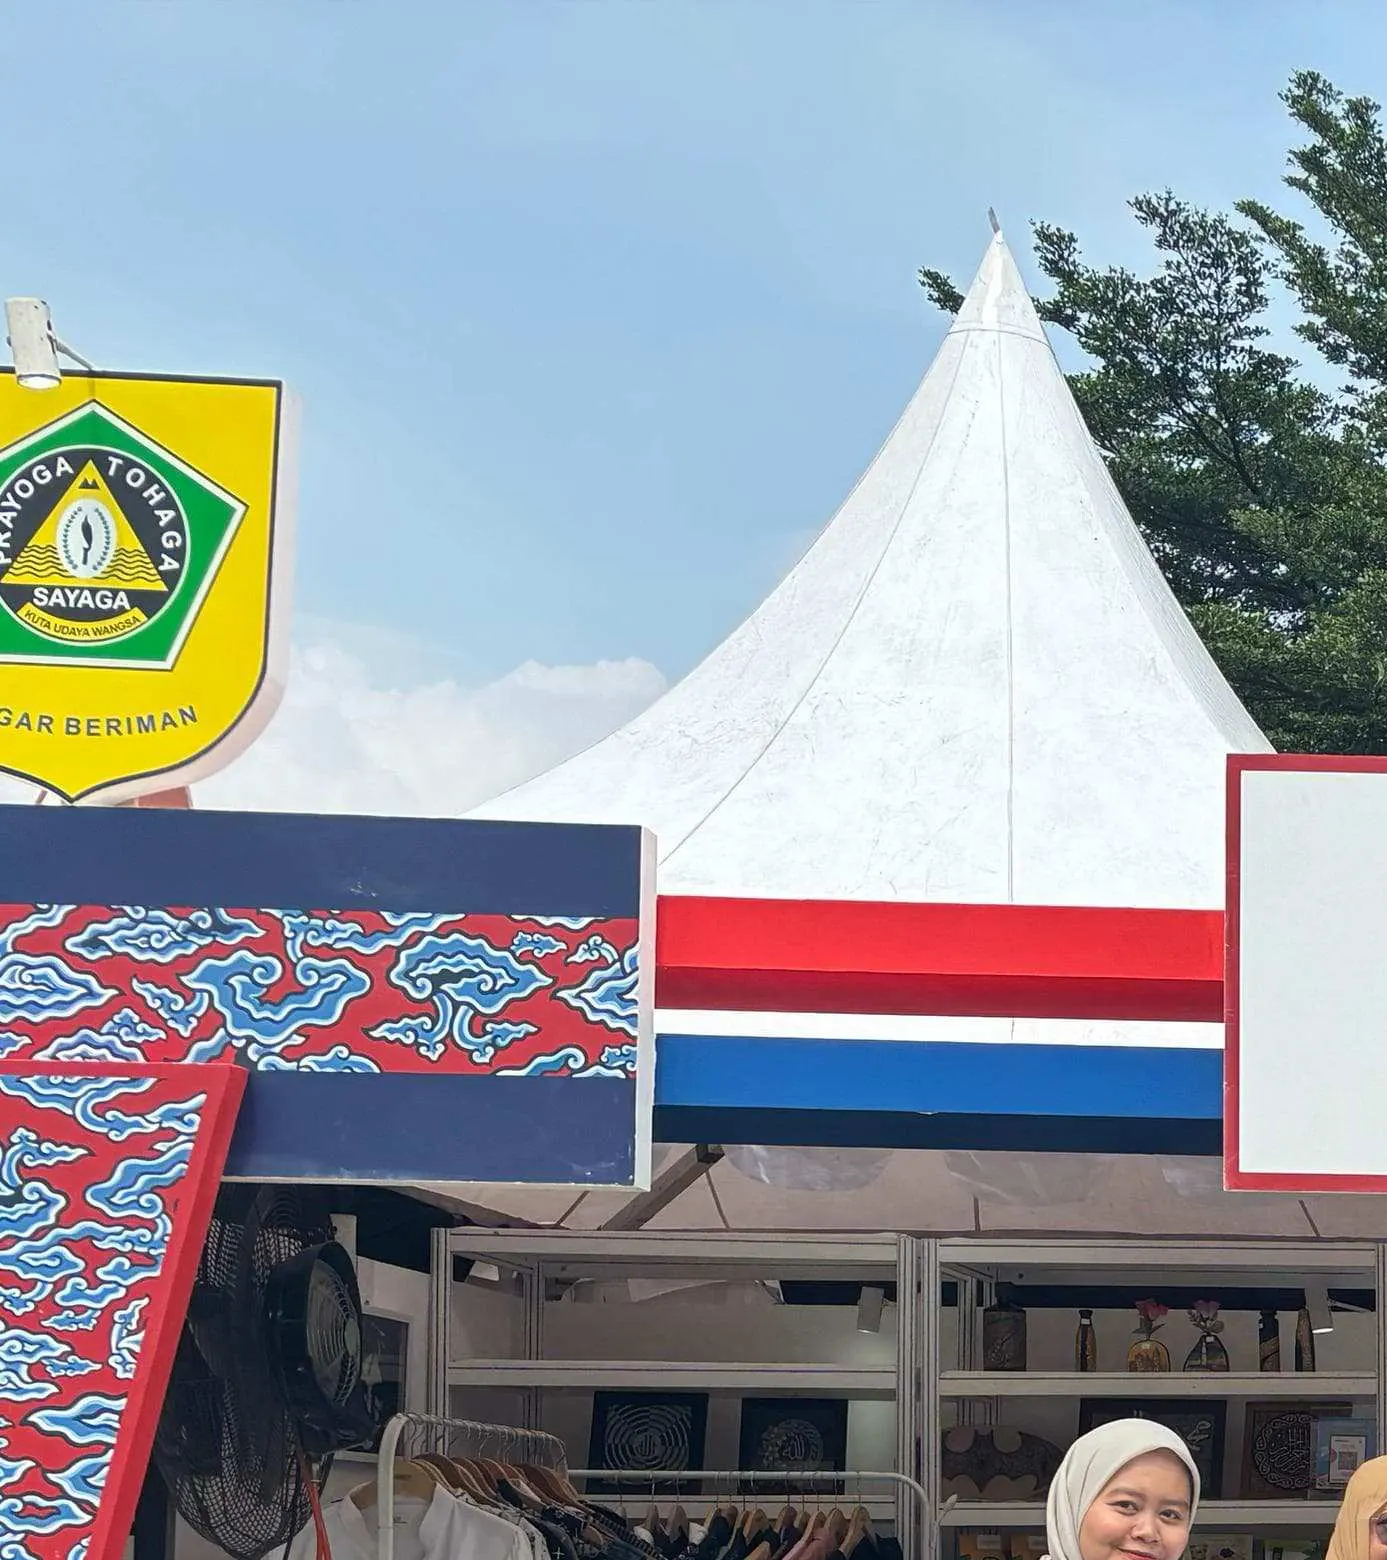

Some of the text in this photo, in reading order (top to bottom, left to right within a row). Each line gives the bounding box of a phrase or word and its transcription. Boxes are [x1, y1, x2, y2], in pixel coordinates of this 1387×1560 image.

[107, 455, 183, 572] TOHAGA
[33, 587, 131, 611] SAYAGA
[24, 609, 141, 638] KUTA UDAYA WANGSA
[65, 704, 198, 737] BERIMAN
